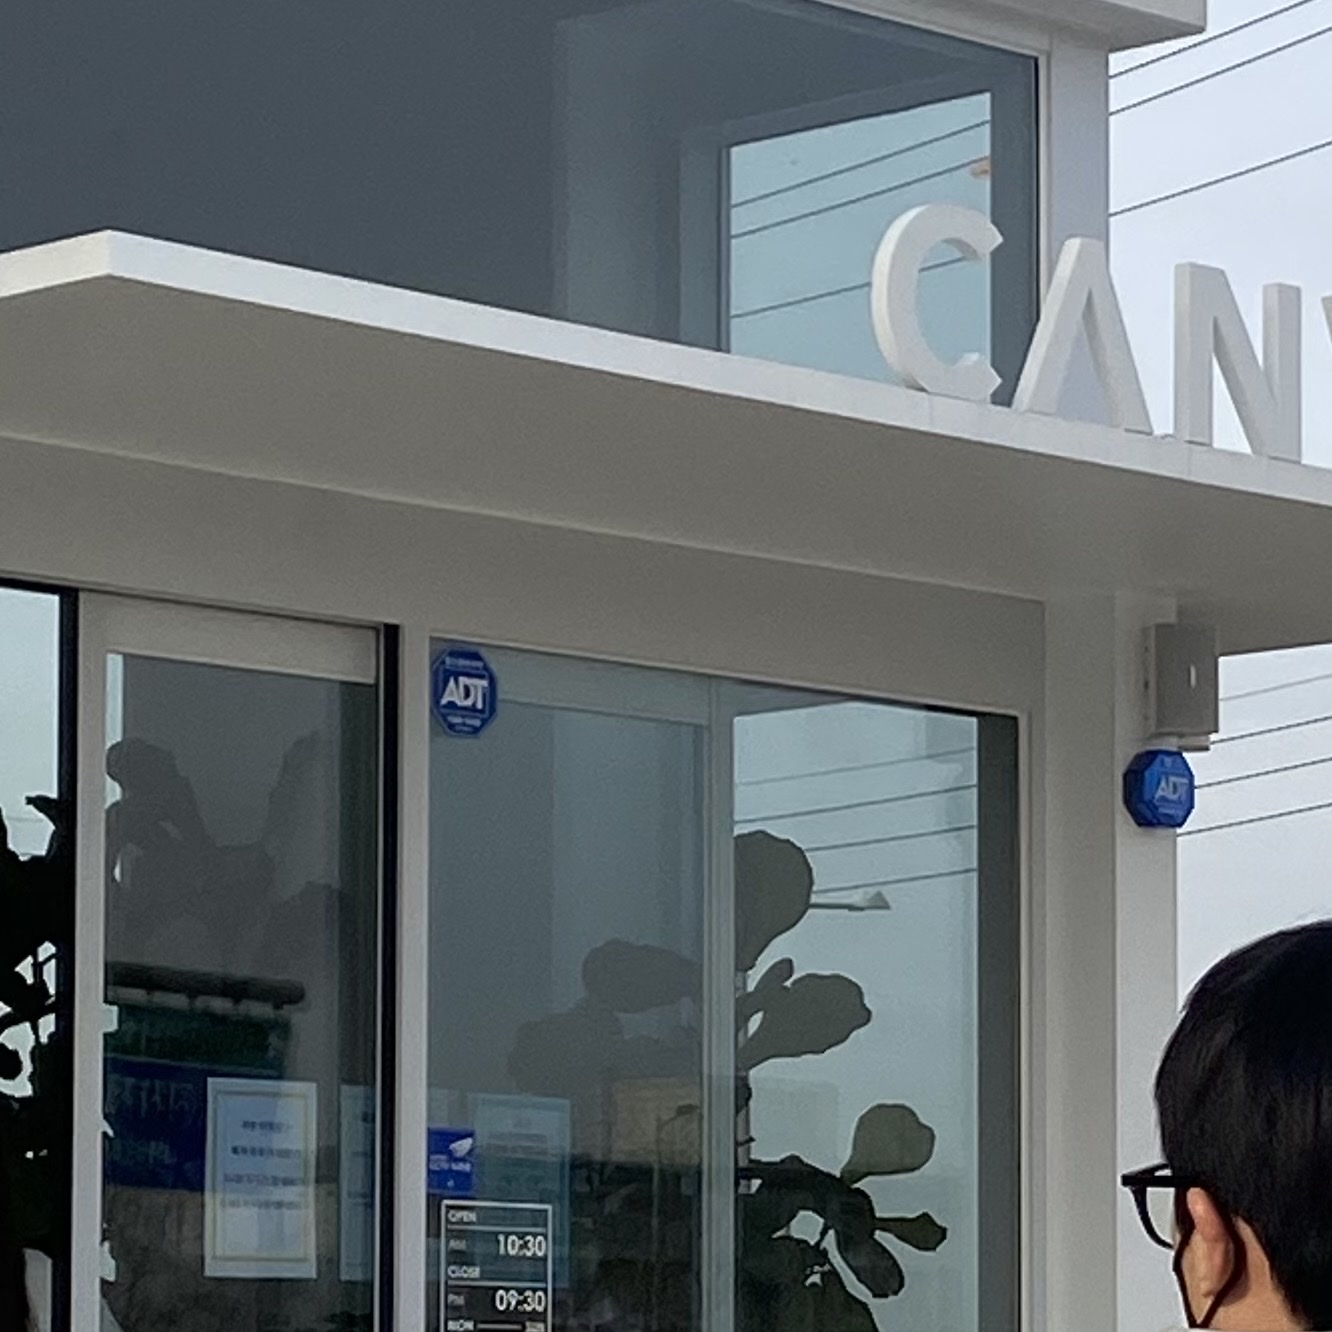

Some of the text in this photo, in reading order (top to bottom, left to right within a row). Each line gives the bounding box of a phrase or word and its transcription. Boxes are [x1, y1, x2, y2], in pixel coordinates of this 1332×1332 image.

[440, 676, 488, 709] ADT
[1153, 774, 1189, 802] ADT
[447, 1210, 477, 1223] OPEN
[497, 1233, 546, 1257] 10:30
[495, 1289, 546, 1313] 09:30
